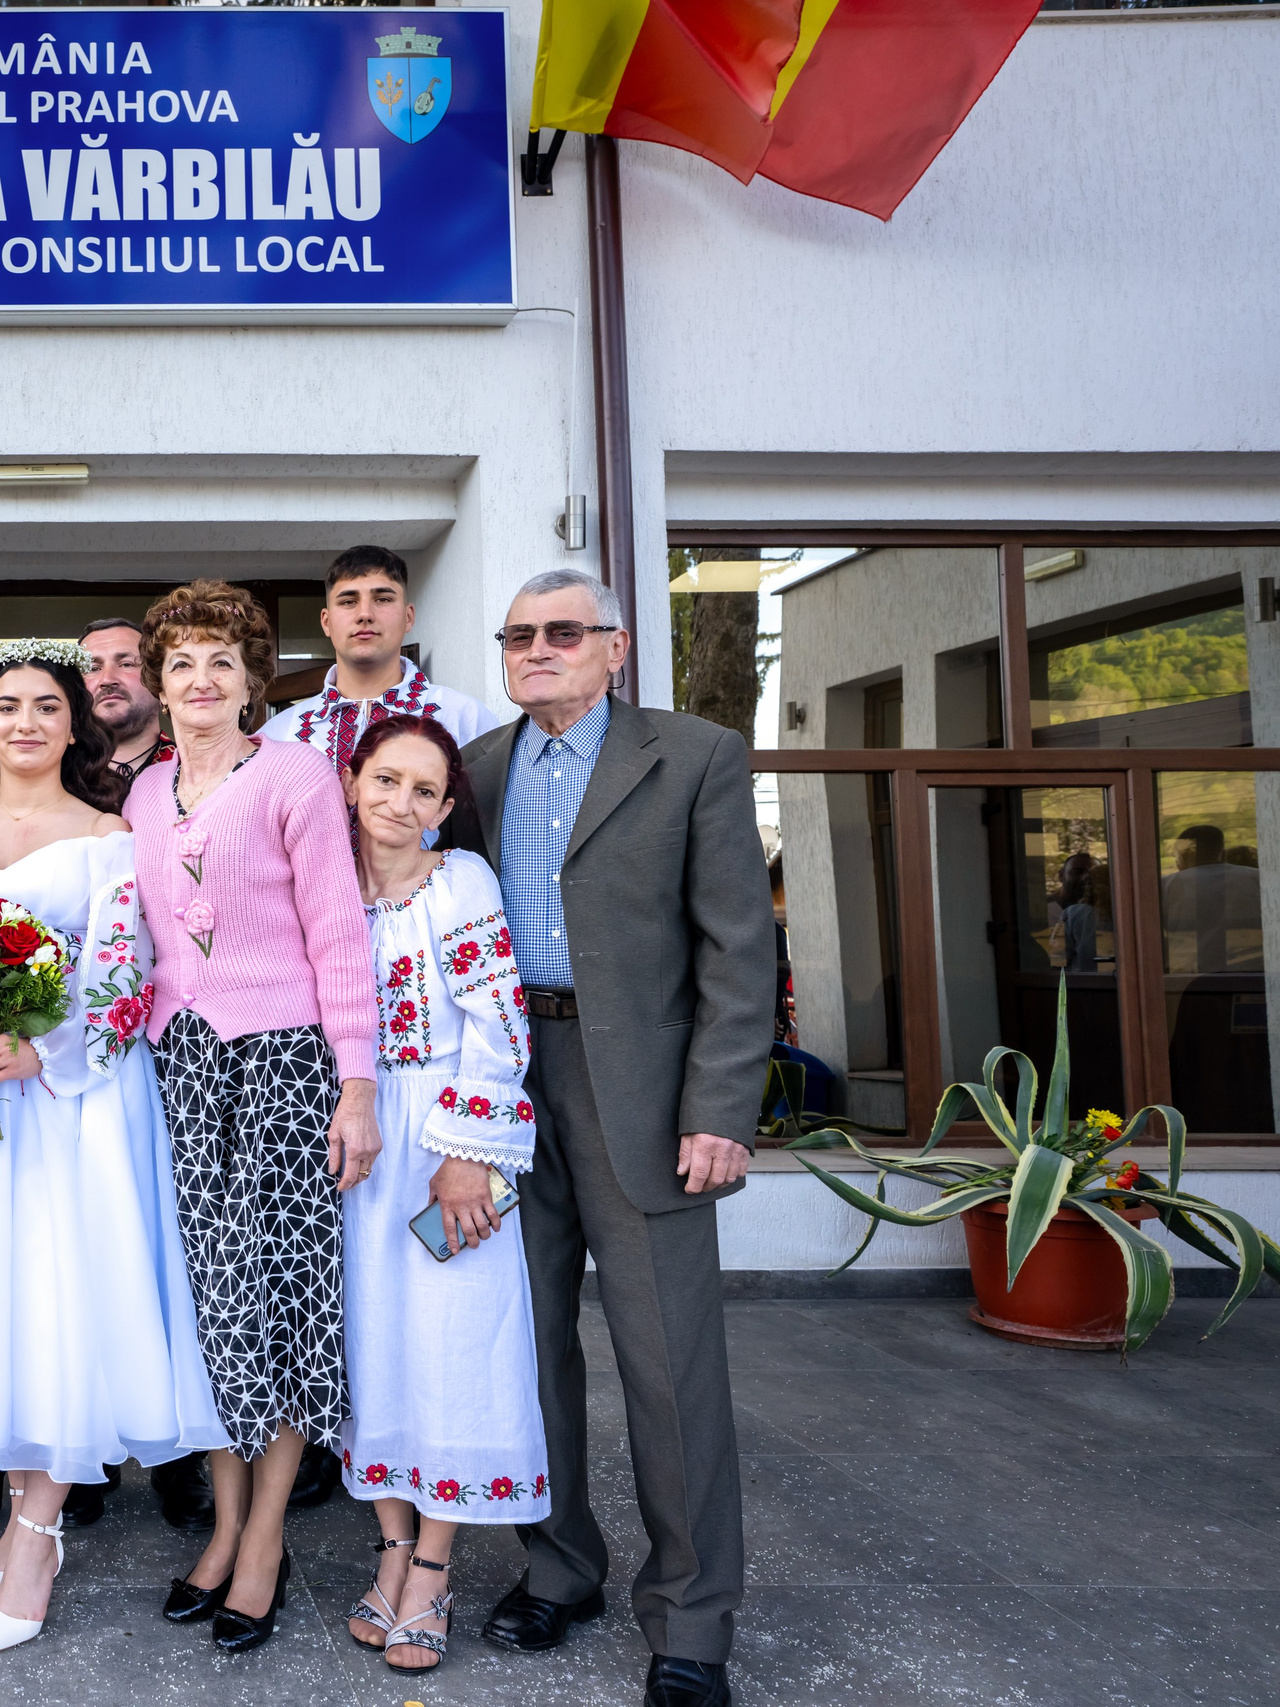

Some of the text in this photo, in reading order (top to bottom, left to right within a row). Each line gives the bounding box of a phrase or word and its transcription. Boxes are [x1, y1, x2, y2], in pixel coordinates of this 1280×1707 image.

[31, 90, 239, 123] PRAHOVA
[22, 132, 381, 221] VĂRBILĂU
[236, 236, 384, 273] LOCAL
